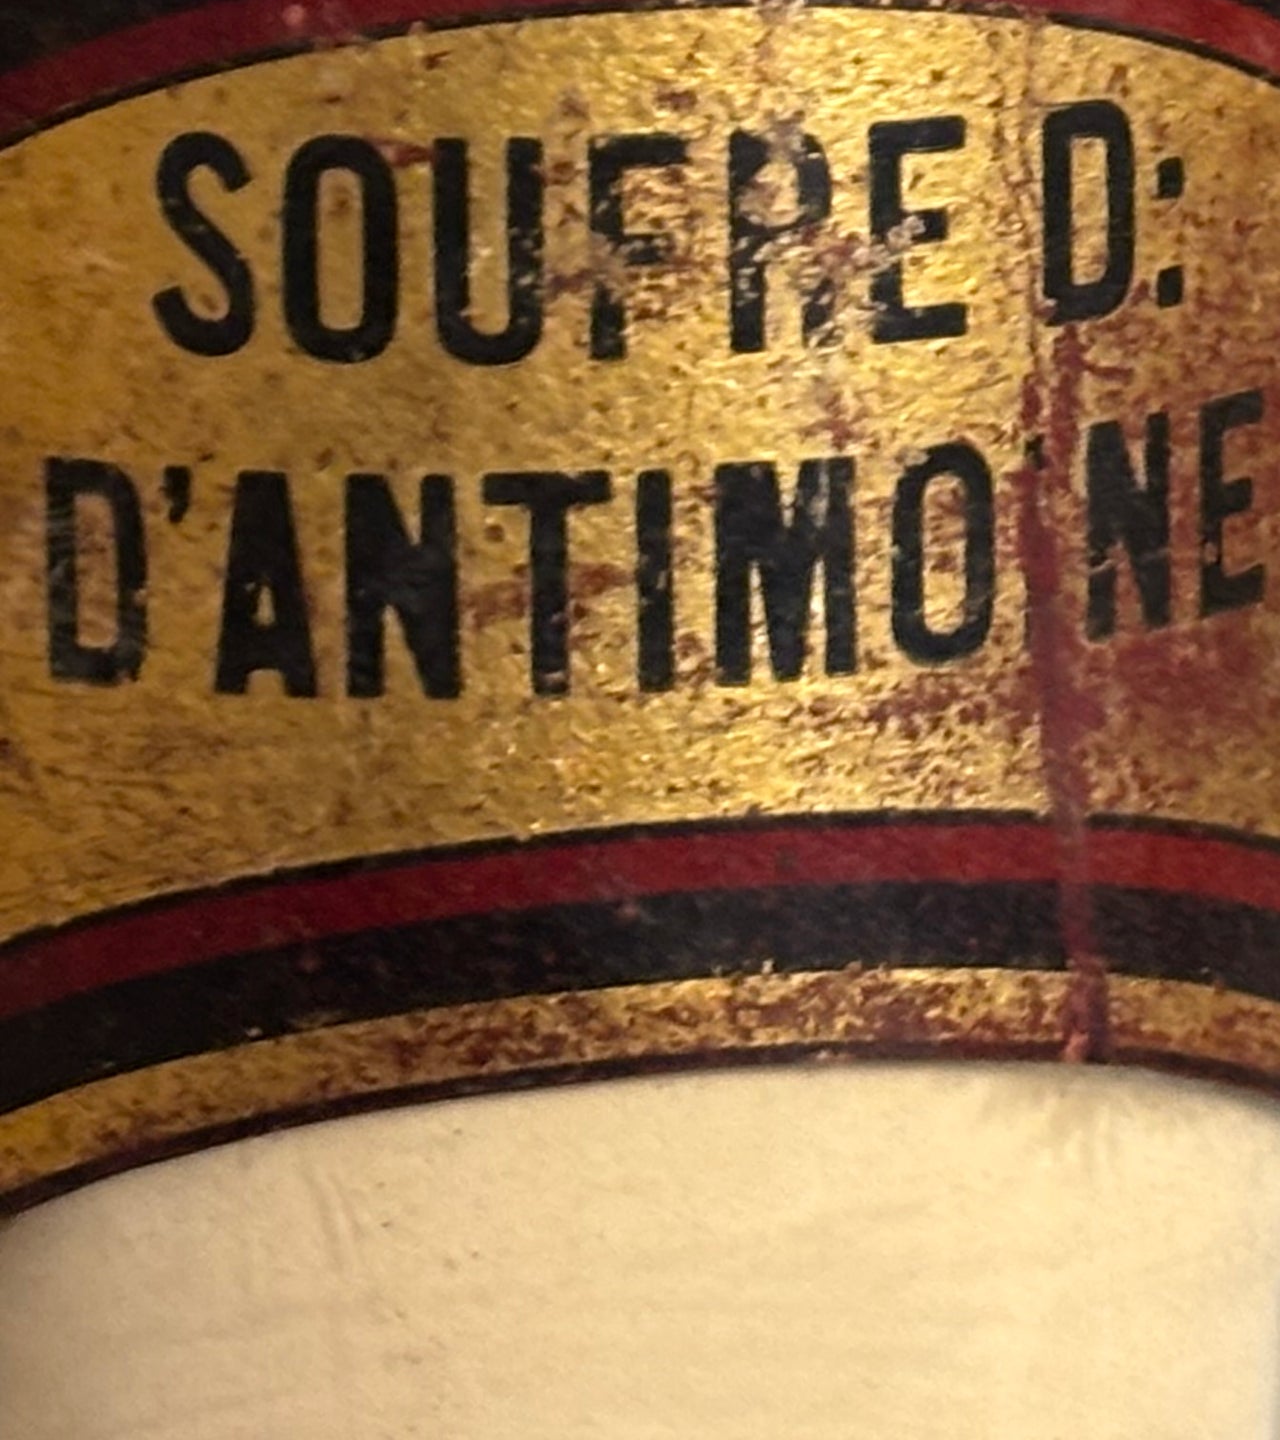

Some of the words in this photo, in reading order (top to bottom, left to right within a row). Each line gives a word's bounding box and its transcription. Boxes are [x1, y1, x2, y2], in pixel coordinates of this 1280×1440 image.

[151, 114, 967, 364] SOUFRE
[1041, 98, 1187, 326] D:
[43, 389, 1264, 699] D'ANTIMONE
